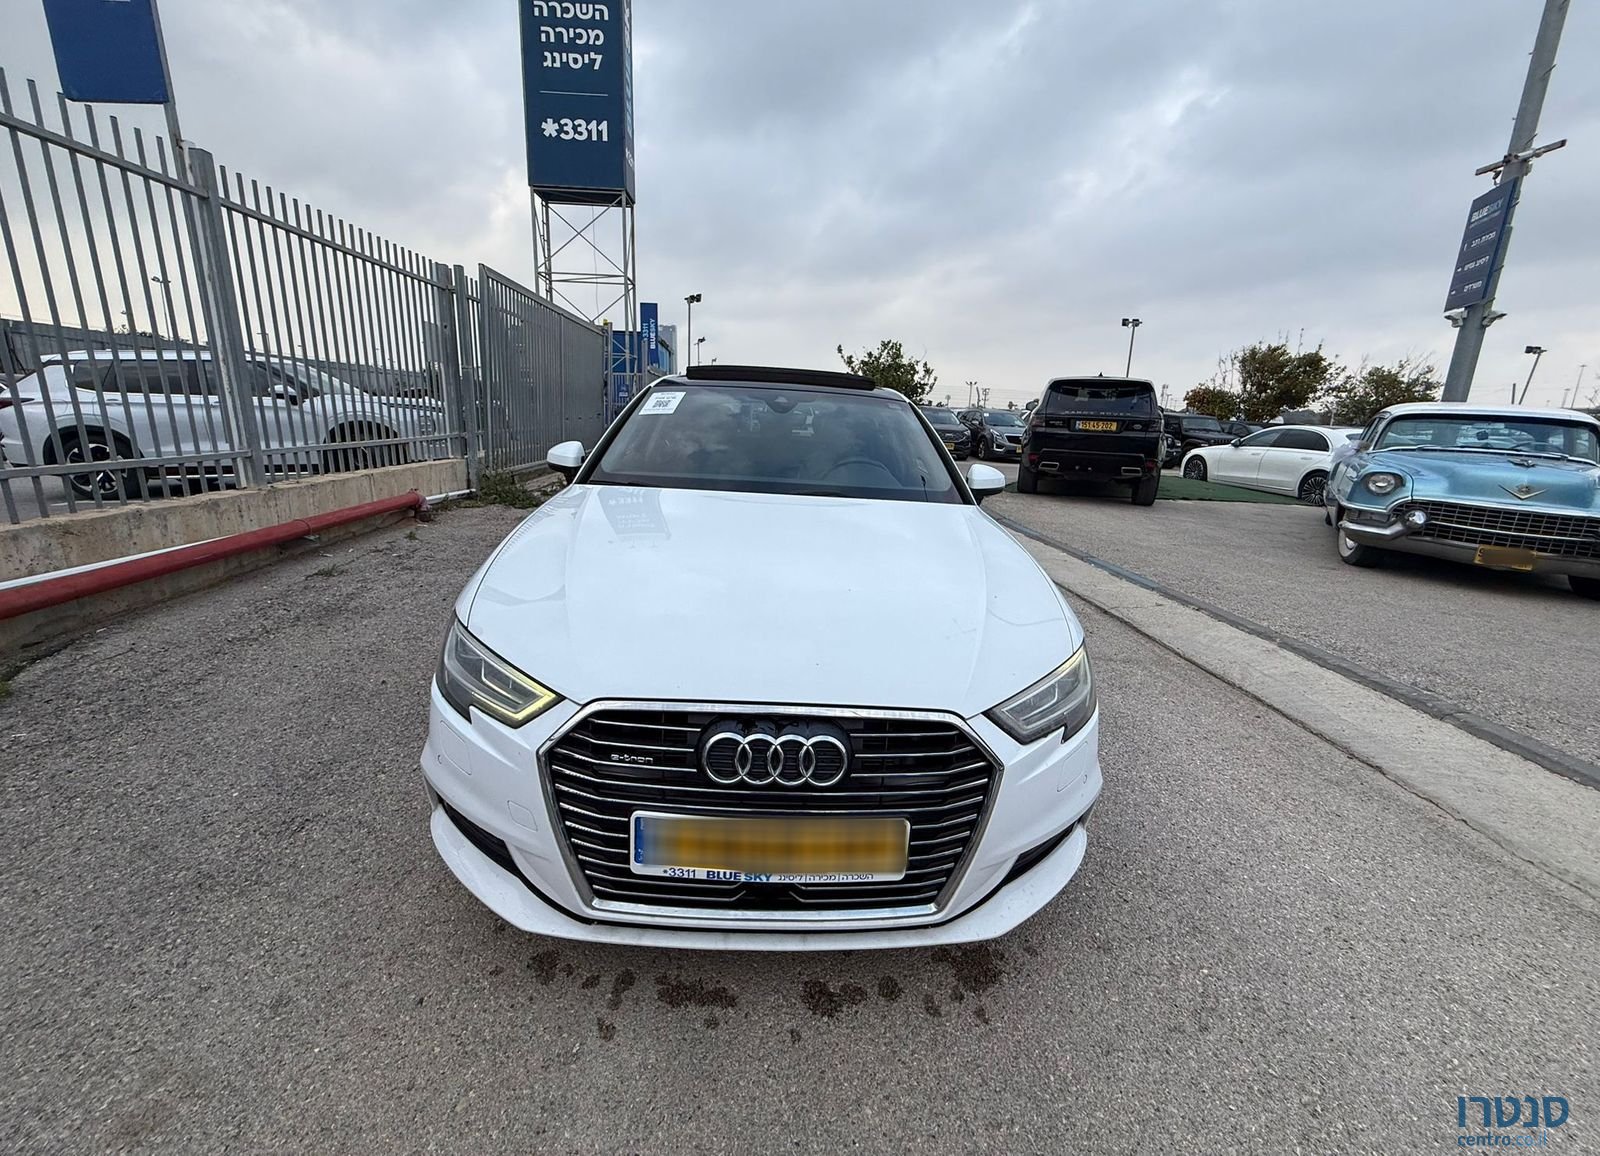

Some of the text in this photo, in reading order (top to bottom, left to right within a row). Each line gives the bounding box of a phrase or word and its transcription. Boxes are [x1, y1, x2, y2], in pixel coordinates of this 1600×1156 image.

[533, 1, 609, 21] השכרה
[540, 26, 605, 46] מכירה
[543, 51, 603, 70] ליסינג
[611, 754, 654, 764] e-tron
[706, 869, 742, 881] BLUE
[743, 872, 773, 882] SKY
